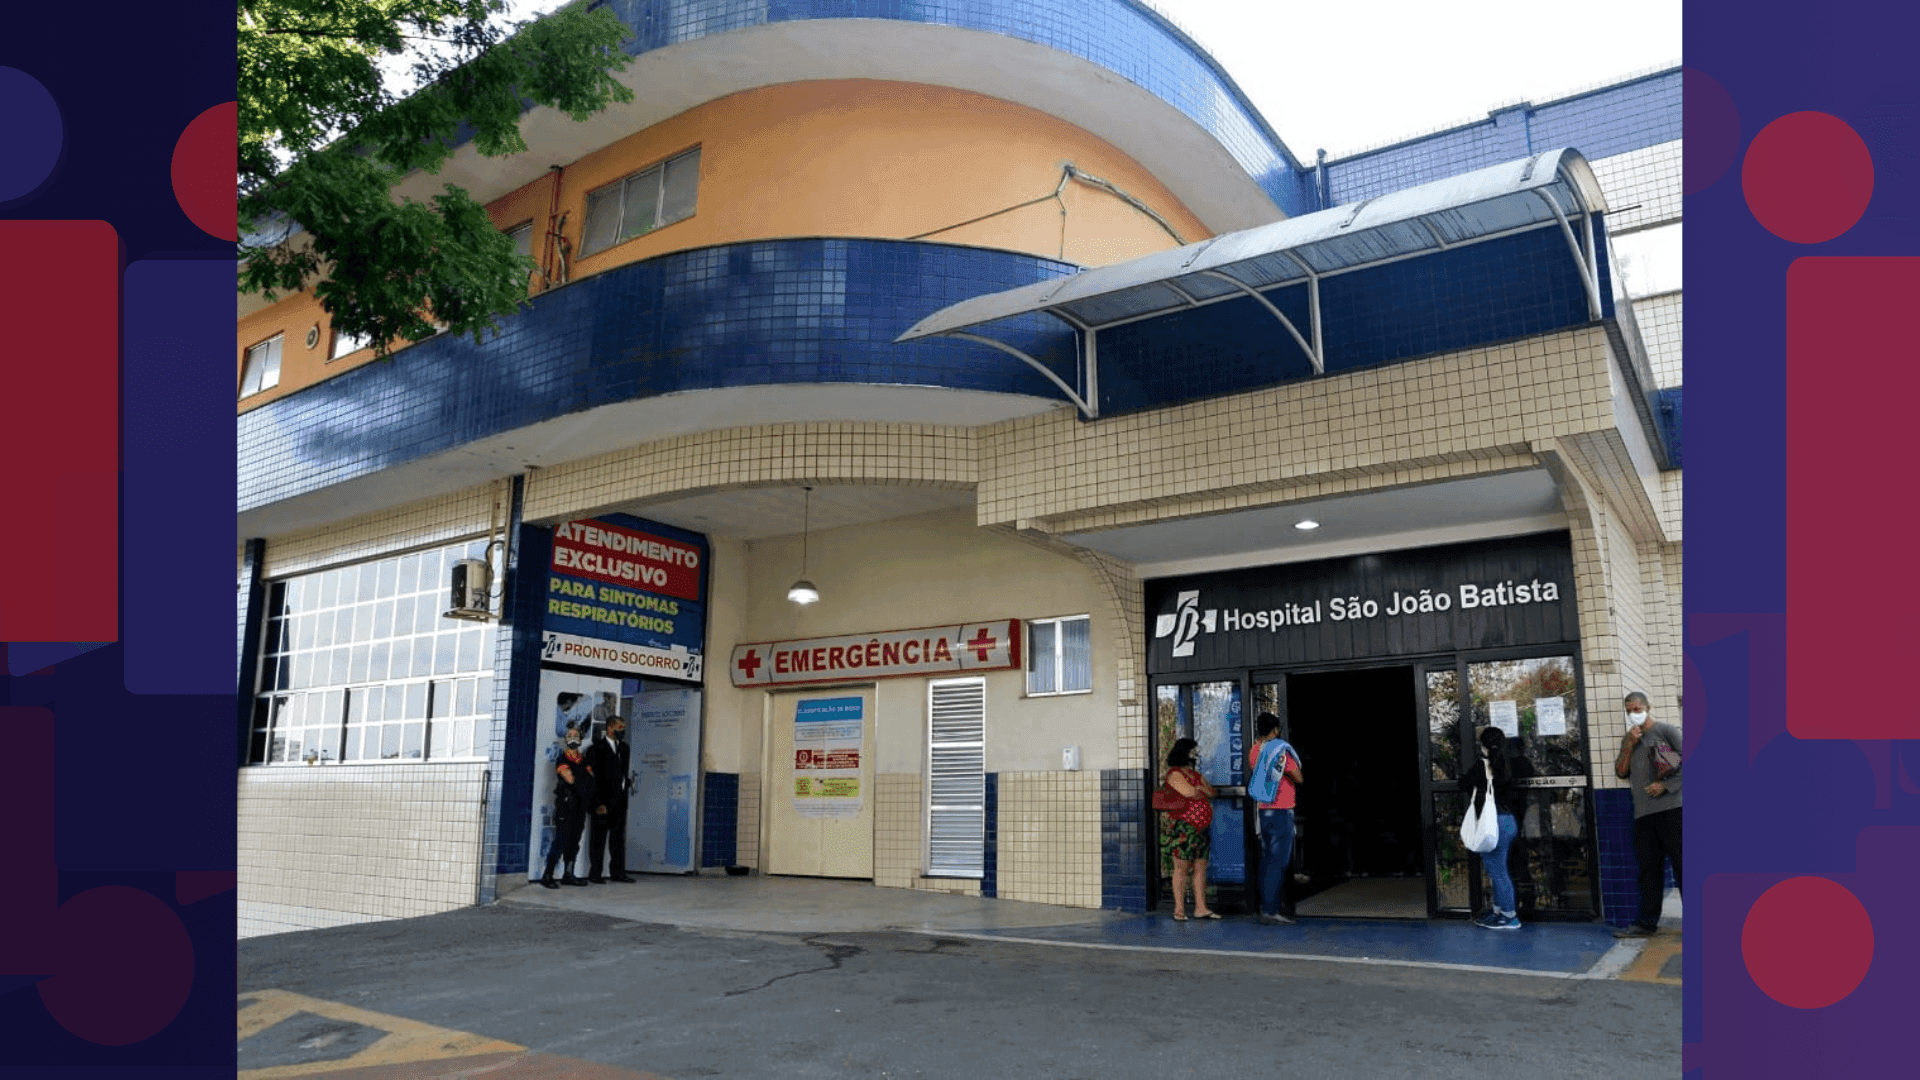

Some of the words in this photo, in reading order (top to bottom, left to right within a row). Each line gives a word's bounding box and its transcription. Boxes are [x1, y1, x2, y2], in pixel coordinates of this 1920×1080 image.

[556, 522, 698, 568] ATENDIMENTO
[554, 546, 668, 586] EXCLUSIVO
[548, 598, 674, 634] RESPIRATÓRIOS
[550, 577, 596, 600] PARA
[599, 587, 679, 616] SINTOMAS
[1223, 600, 1321, 633] Hospital
[1329, 596, 1378, 621] São
[1386, 589, 1452, 616] João
[1459, 578, 1559, 609] Batista
[564, 642, 618, 662] PRONTO
[620, 650, 681, 671] SOCORRO
[774, 637, 953, 674] EMERGÊNCIA
